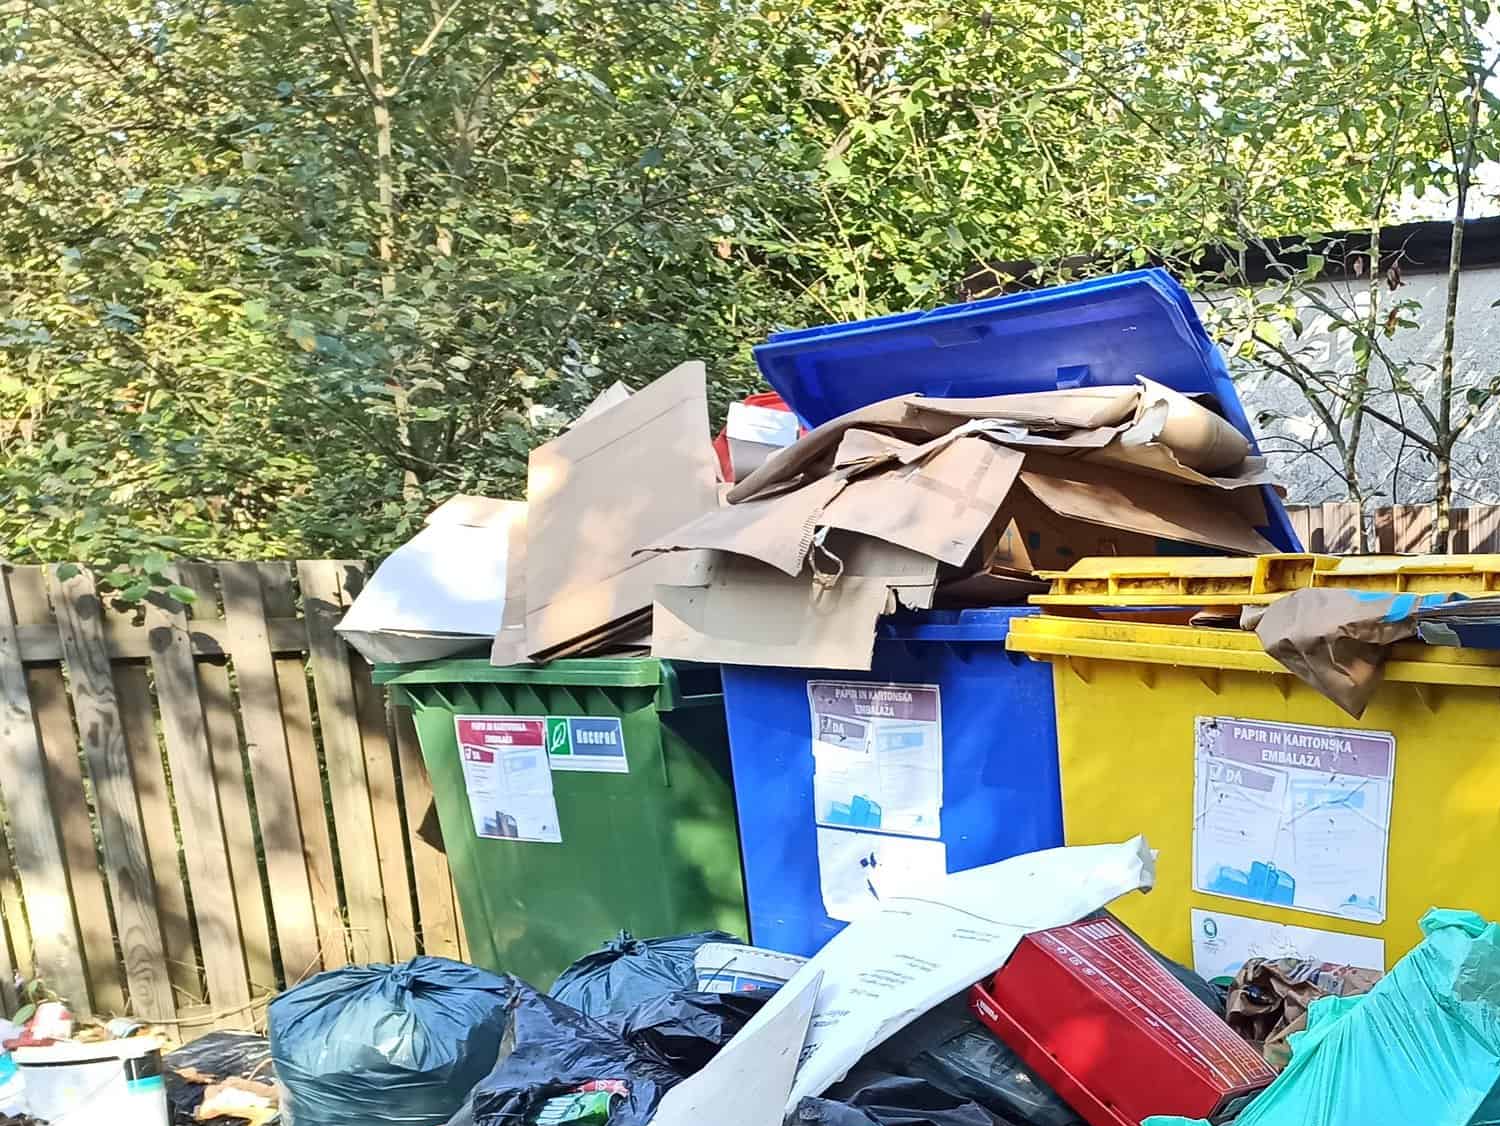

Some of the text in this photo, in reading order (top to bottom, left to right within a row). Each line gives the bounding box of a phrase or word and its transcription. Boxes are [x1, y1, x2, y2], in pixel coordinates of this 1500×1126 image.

[1234, 727, 1352, 753] PAPIR IN KARTONSKA
[1261, 749, 1321, 768] EMBALAŽA
[1226, 769, 1243, 784] DA
